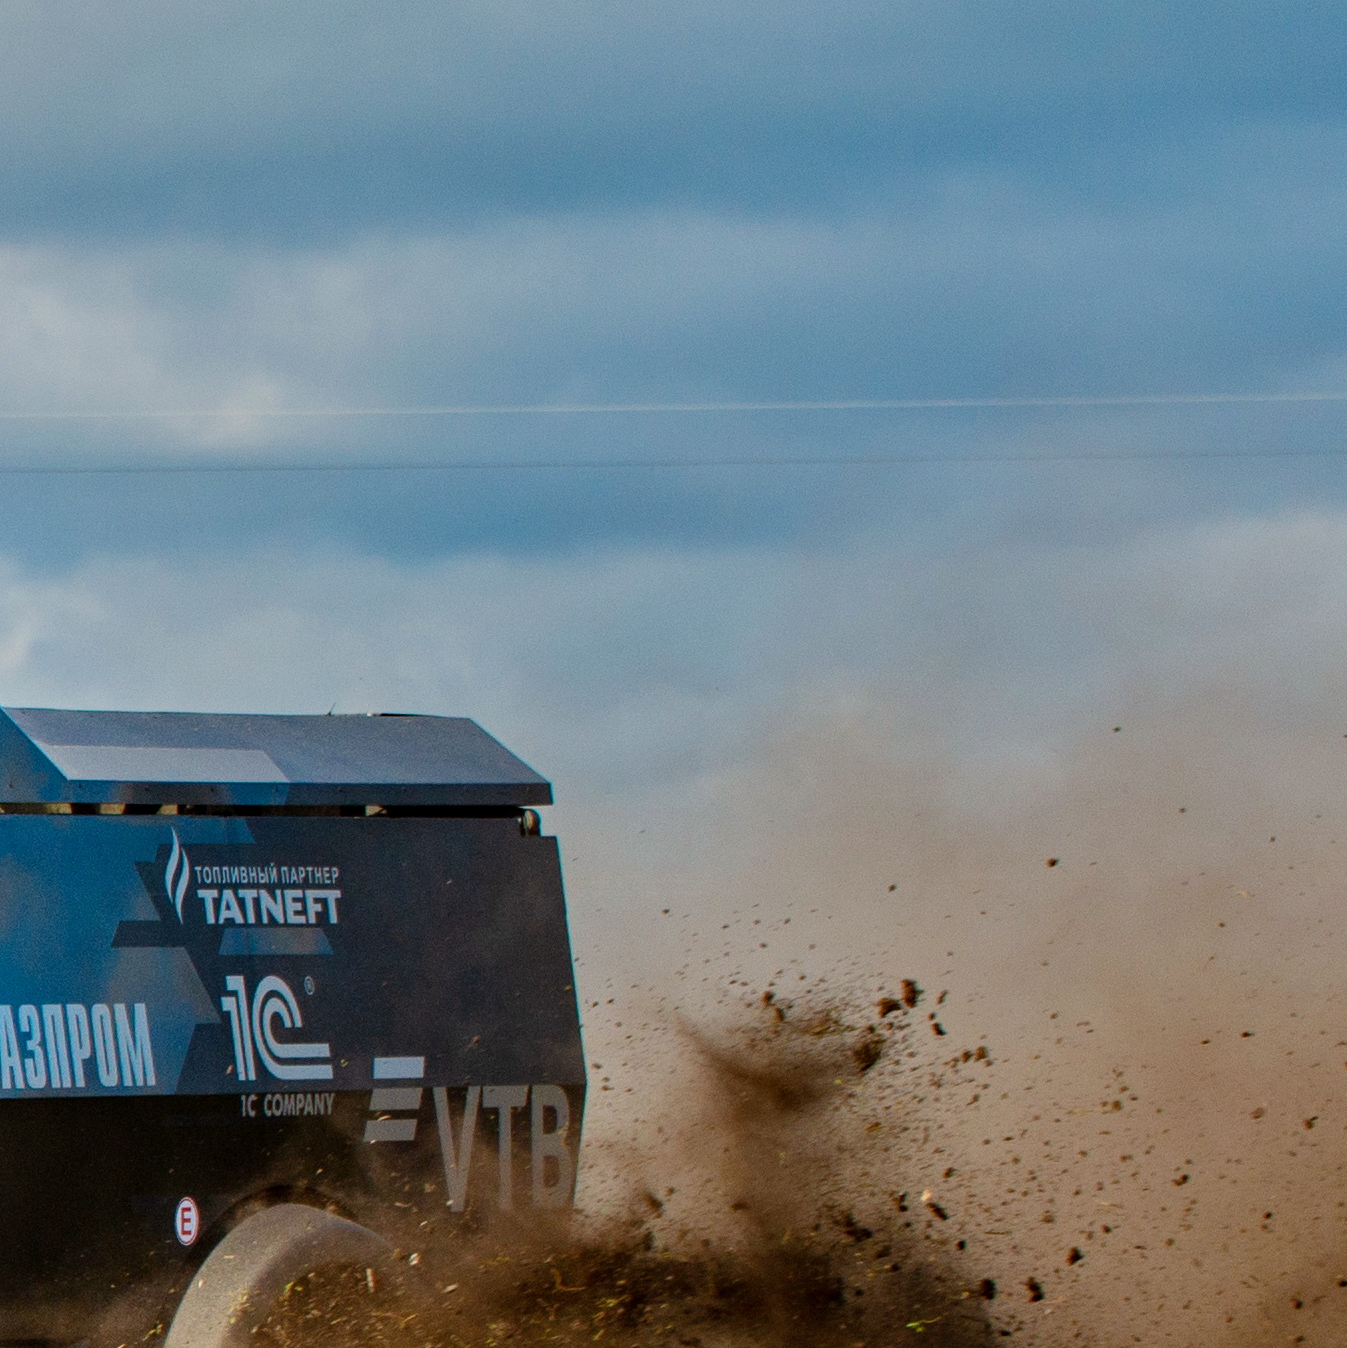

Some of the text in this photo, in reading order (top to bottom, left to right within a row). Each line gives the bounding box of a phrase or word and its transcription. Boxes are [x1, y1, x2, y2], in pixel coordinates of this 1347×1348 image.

[194, 863, 339, 886] ТОПЛИВНЫЙ ПАРТНЕР
[197, 890, 342, 925] TATNEFT
[264, 1092, 335, 1118] COMPANY
[433, 1084, 574, 1213] VTB
[180, 1207, 193, 1236] E
